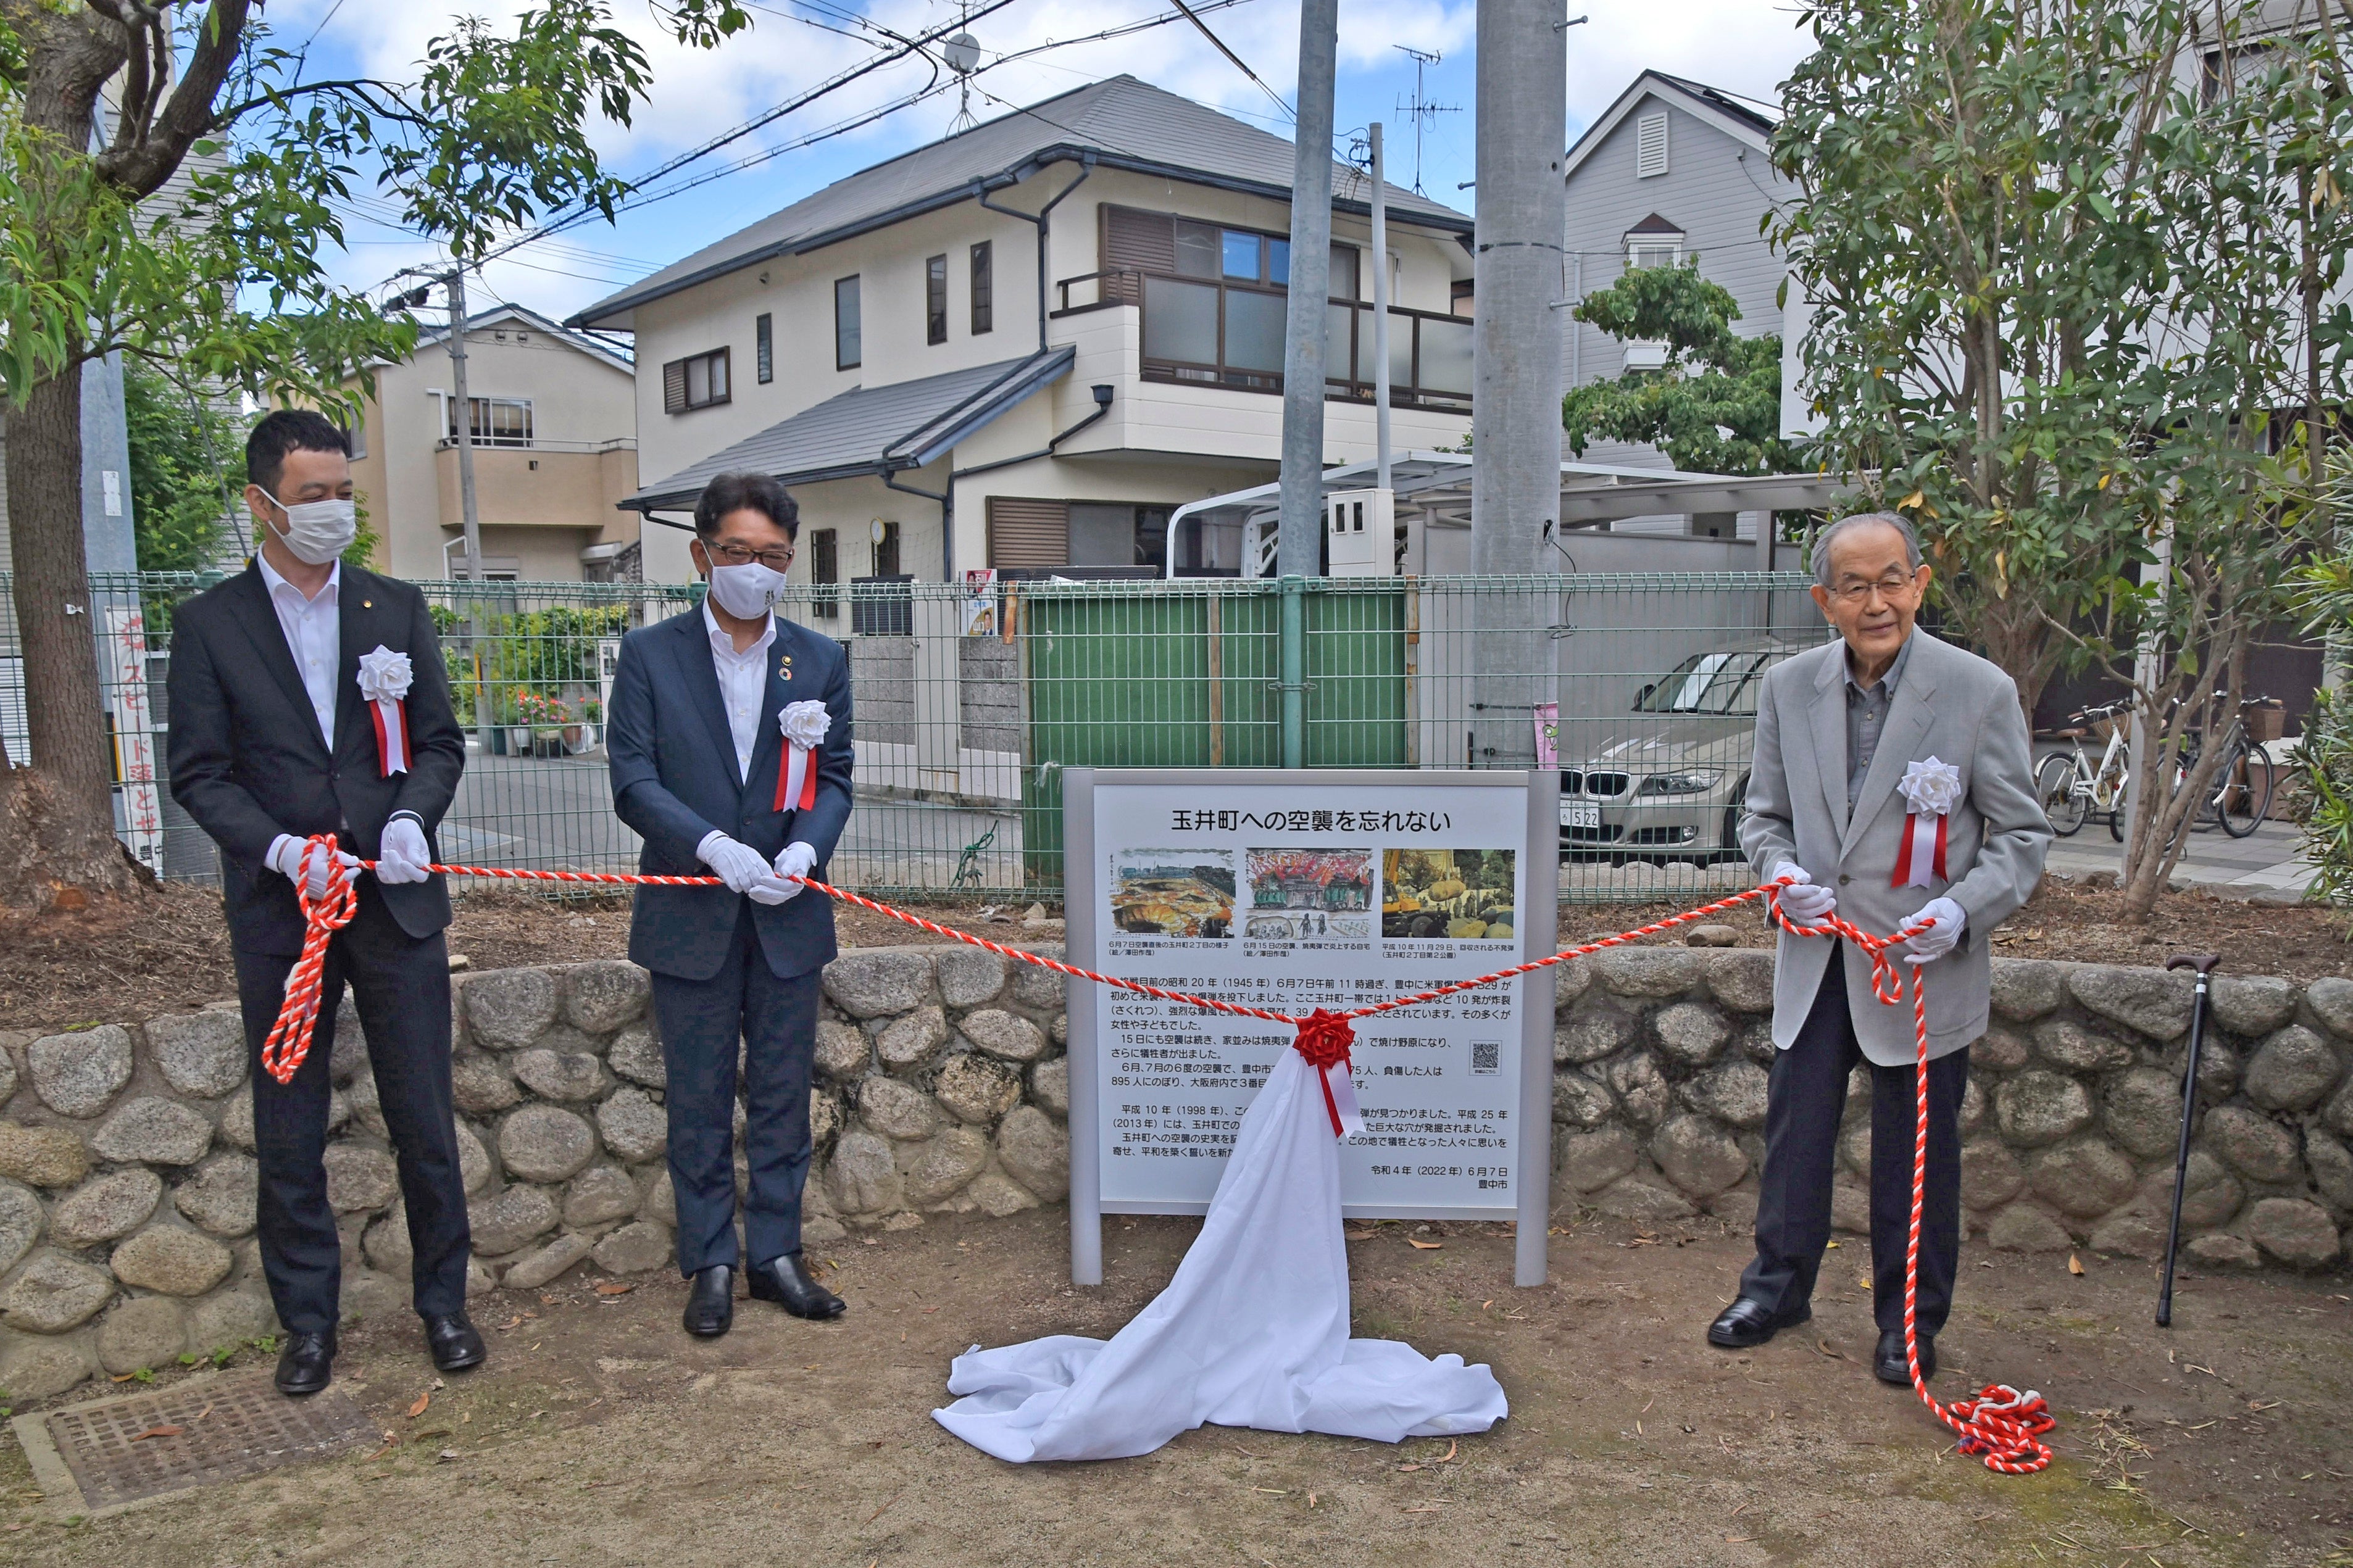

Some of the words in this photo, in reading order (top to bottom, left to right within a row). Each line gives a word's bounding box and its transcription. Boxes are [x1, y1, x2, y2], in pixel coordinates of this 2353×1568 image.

[1171, 809, 1451, 832] 玉井町への空襲を忘れない
[1111, 1020, 1202, 1031] 女性や子どもでした。
[1111, 1048, 1222, 1059] さらに犠牲者が出ました。
[1122, 1063, 1276, 1074] 6月、7月の6度の空襲で、豊中市
[1478, 1179, 1508, 1190] 豊中市
